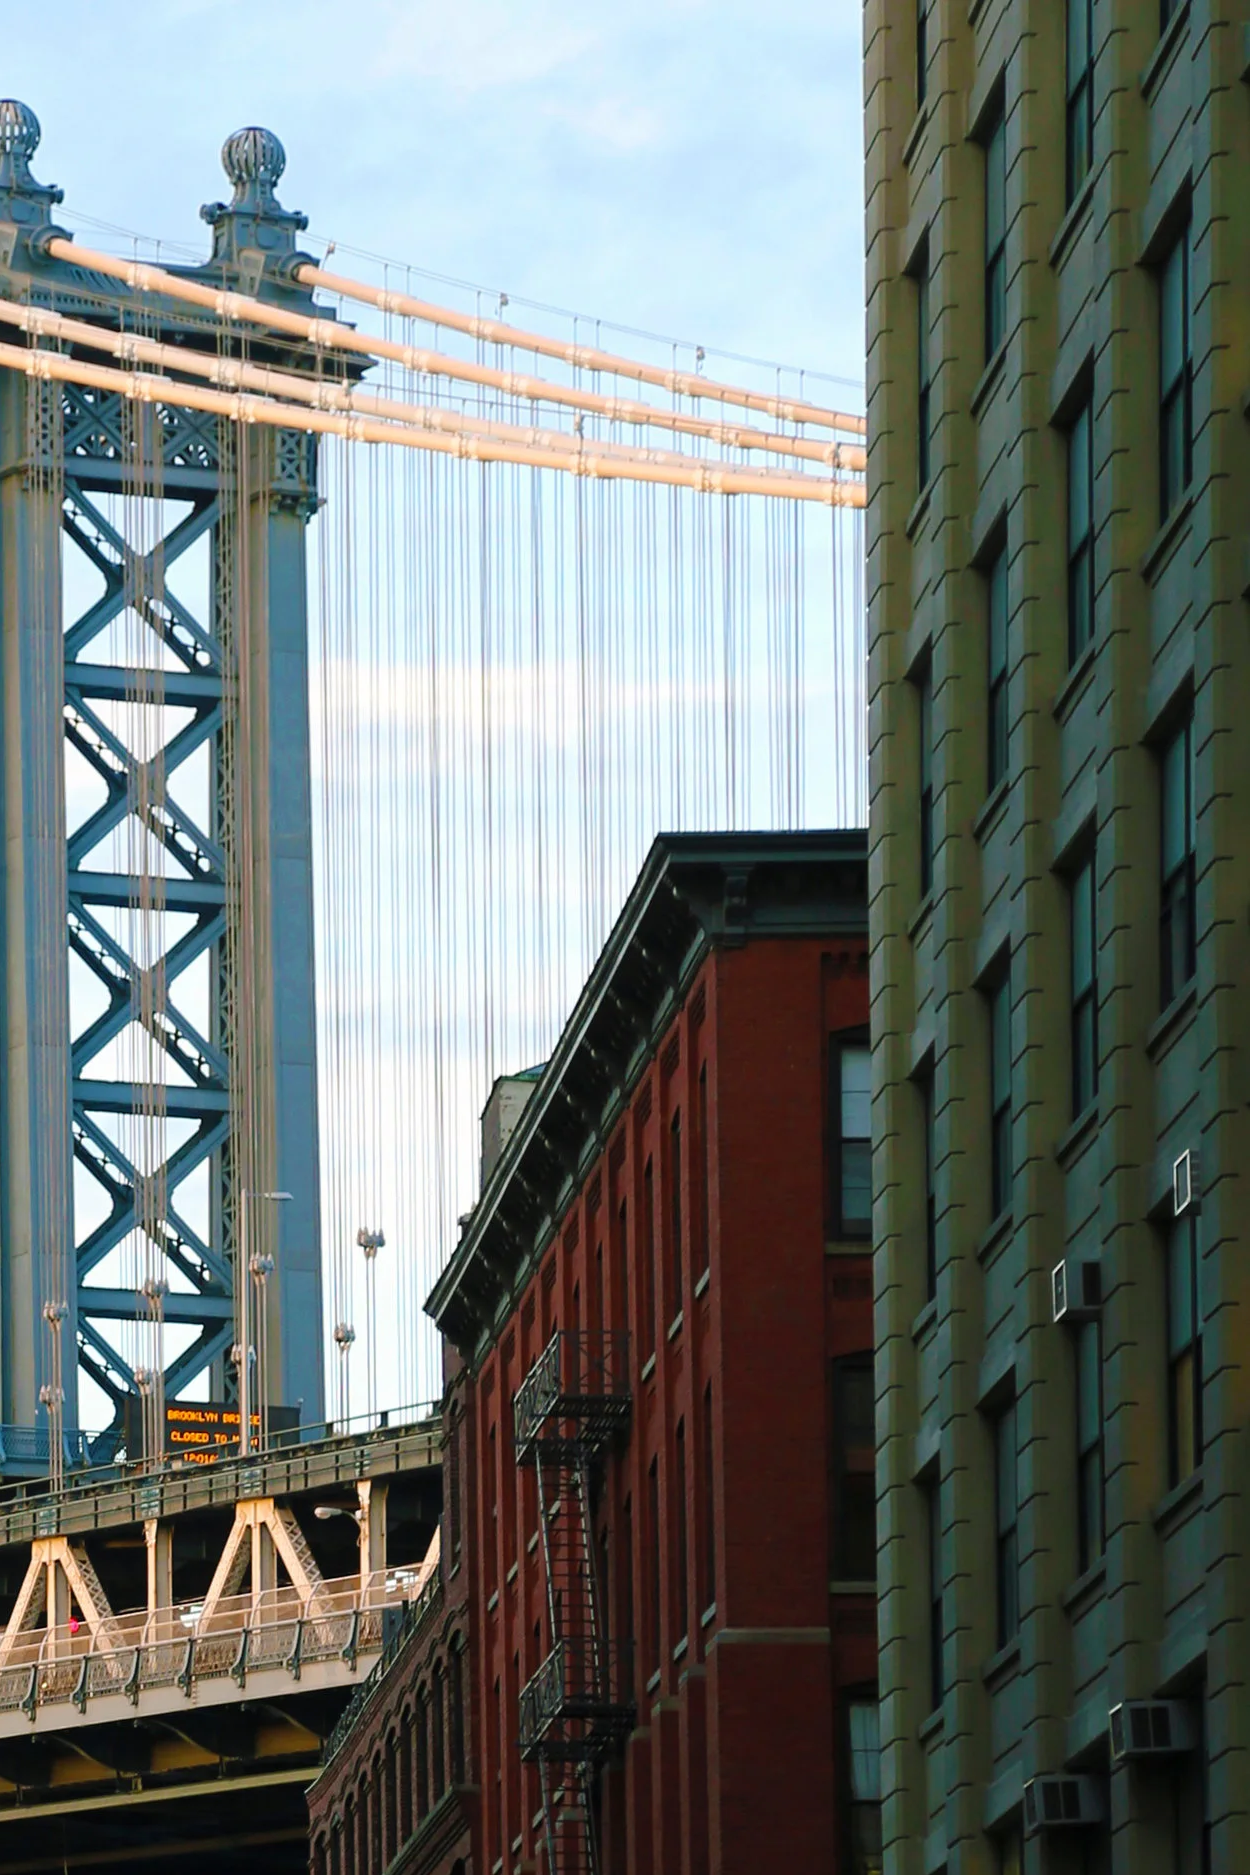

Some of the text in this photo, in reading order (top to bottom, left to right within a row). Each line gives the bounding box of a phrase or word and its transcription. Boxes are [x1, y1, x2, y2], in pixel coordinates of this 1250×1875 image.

[167, 1410, 261, 1425] BROOKLYN BRIGE
[171, 1431, 210, 1443] CLOSED
[214, 1434, 228, 1445] TO
